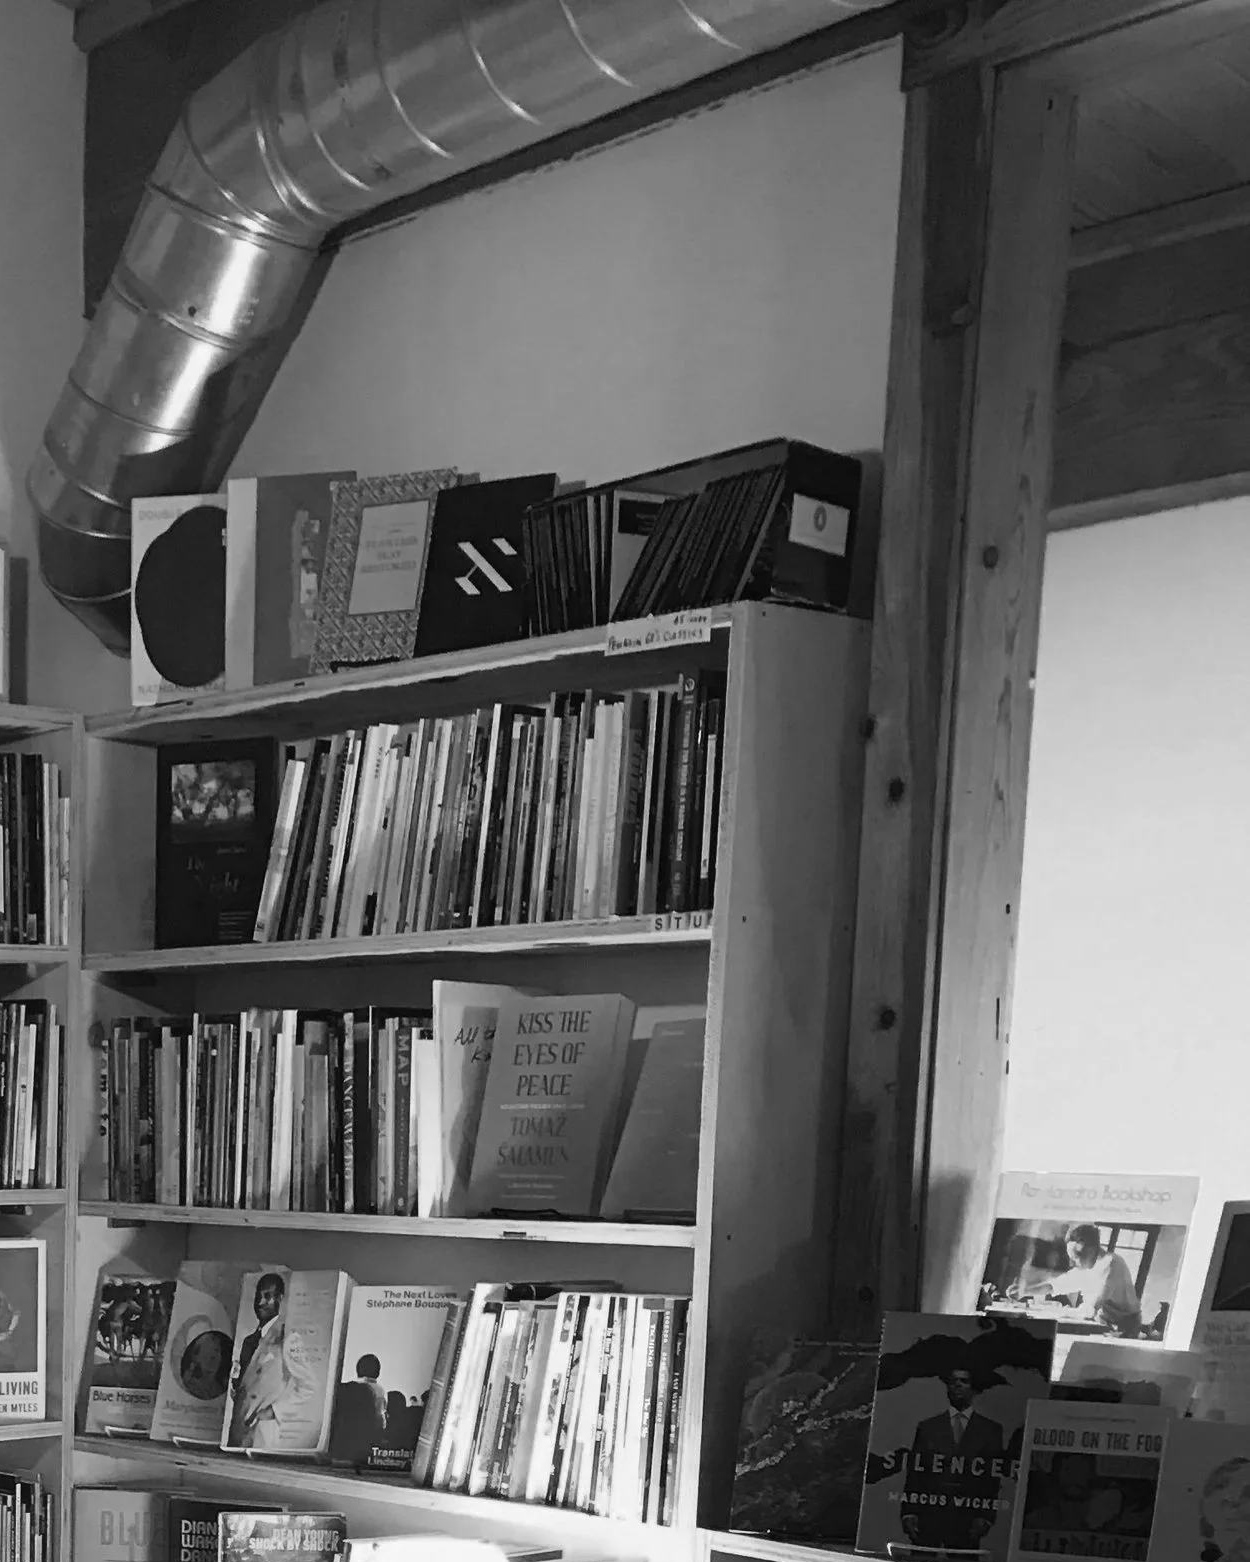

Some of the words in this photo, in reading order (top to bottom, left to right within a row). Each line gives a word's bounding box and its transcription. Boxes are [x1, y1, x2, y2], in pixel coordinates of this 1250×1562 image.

[654, 916, 665, 930] S
[673, 915, 682, 929] T
[693, 914, 702, 928] U
[517, 1011, 554, 1035] KISS
[559, 1010, 592, 1033] THE
[396, 1034, 409, 1087] MAP
[513, 1043, 558, 1066] EYES
[561, 1042, 586, 1064] OF
[515, 1074, 573, 1097] PEACE
[1102, 1184, 1172, 1203] Bookshop
[383, 1290, 401, 1299] The
[403, 1290, 426, 1299] Next
[428, 1290, 458, 1299] Loves
[366, 1299, 412, 1309] Stéphane
[414, 1300, 452, 1310] Bouque
[92, 1390, 113, 1402] Blue
[116, 1391, 151, 1404] Horses
[11, 1402, 39, 1413] MYLES
[1033, 1427, 1075, 1447] BLOOD
[1081, 1431, 1101, 1448] ON
[1106, 1432, 1132, 1450] THE
[1136, 1434, 1163, 1453] FOG
[887, 1491, 947, 1506] MARCUS
[181, 1519, 218, 1534] DIAN
[181, 1534, 218, 1548] WAK
[272, 1528, 302, 1540] DEAN
[304, 1529, 339, 1542] YOUNG
[248, 1537, 285, 1551] SHOCK
[287, 1538, 302, 1551] BY
[303, 1539, 339, 1552] SHOCK
[180, 1549, 217, 1562] DAN
